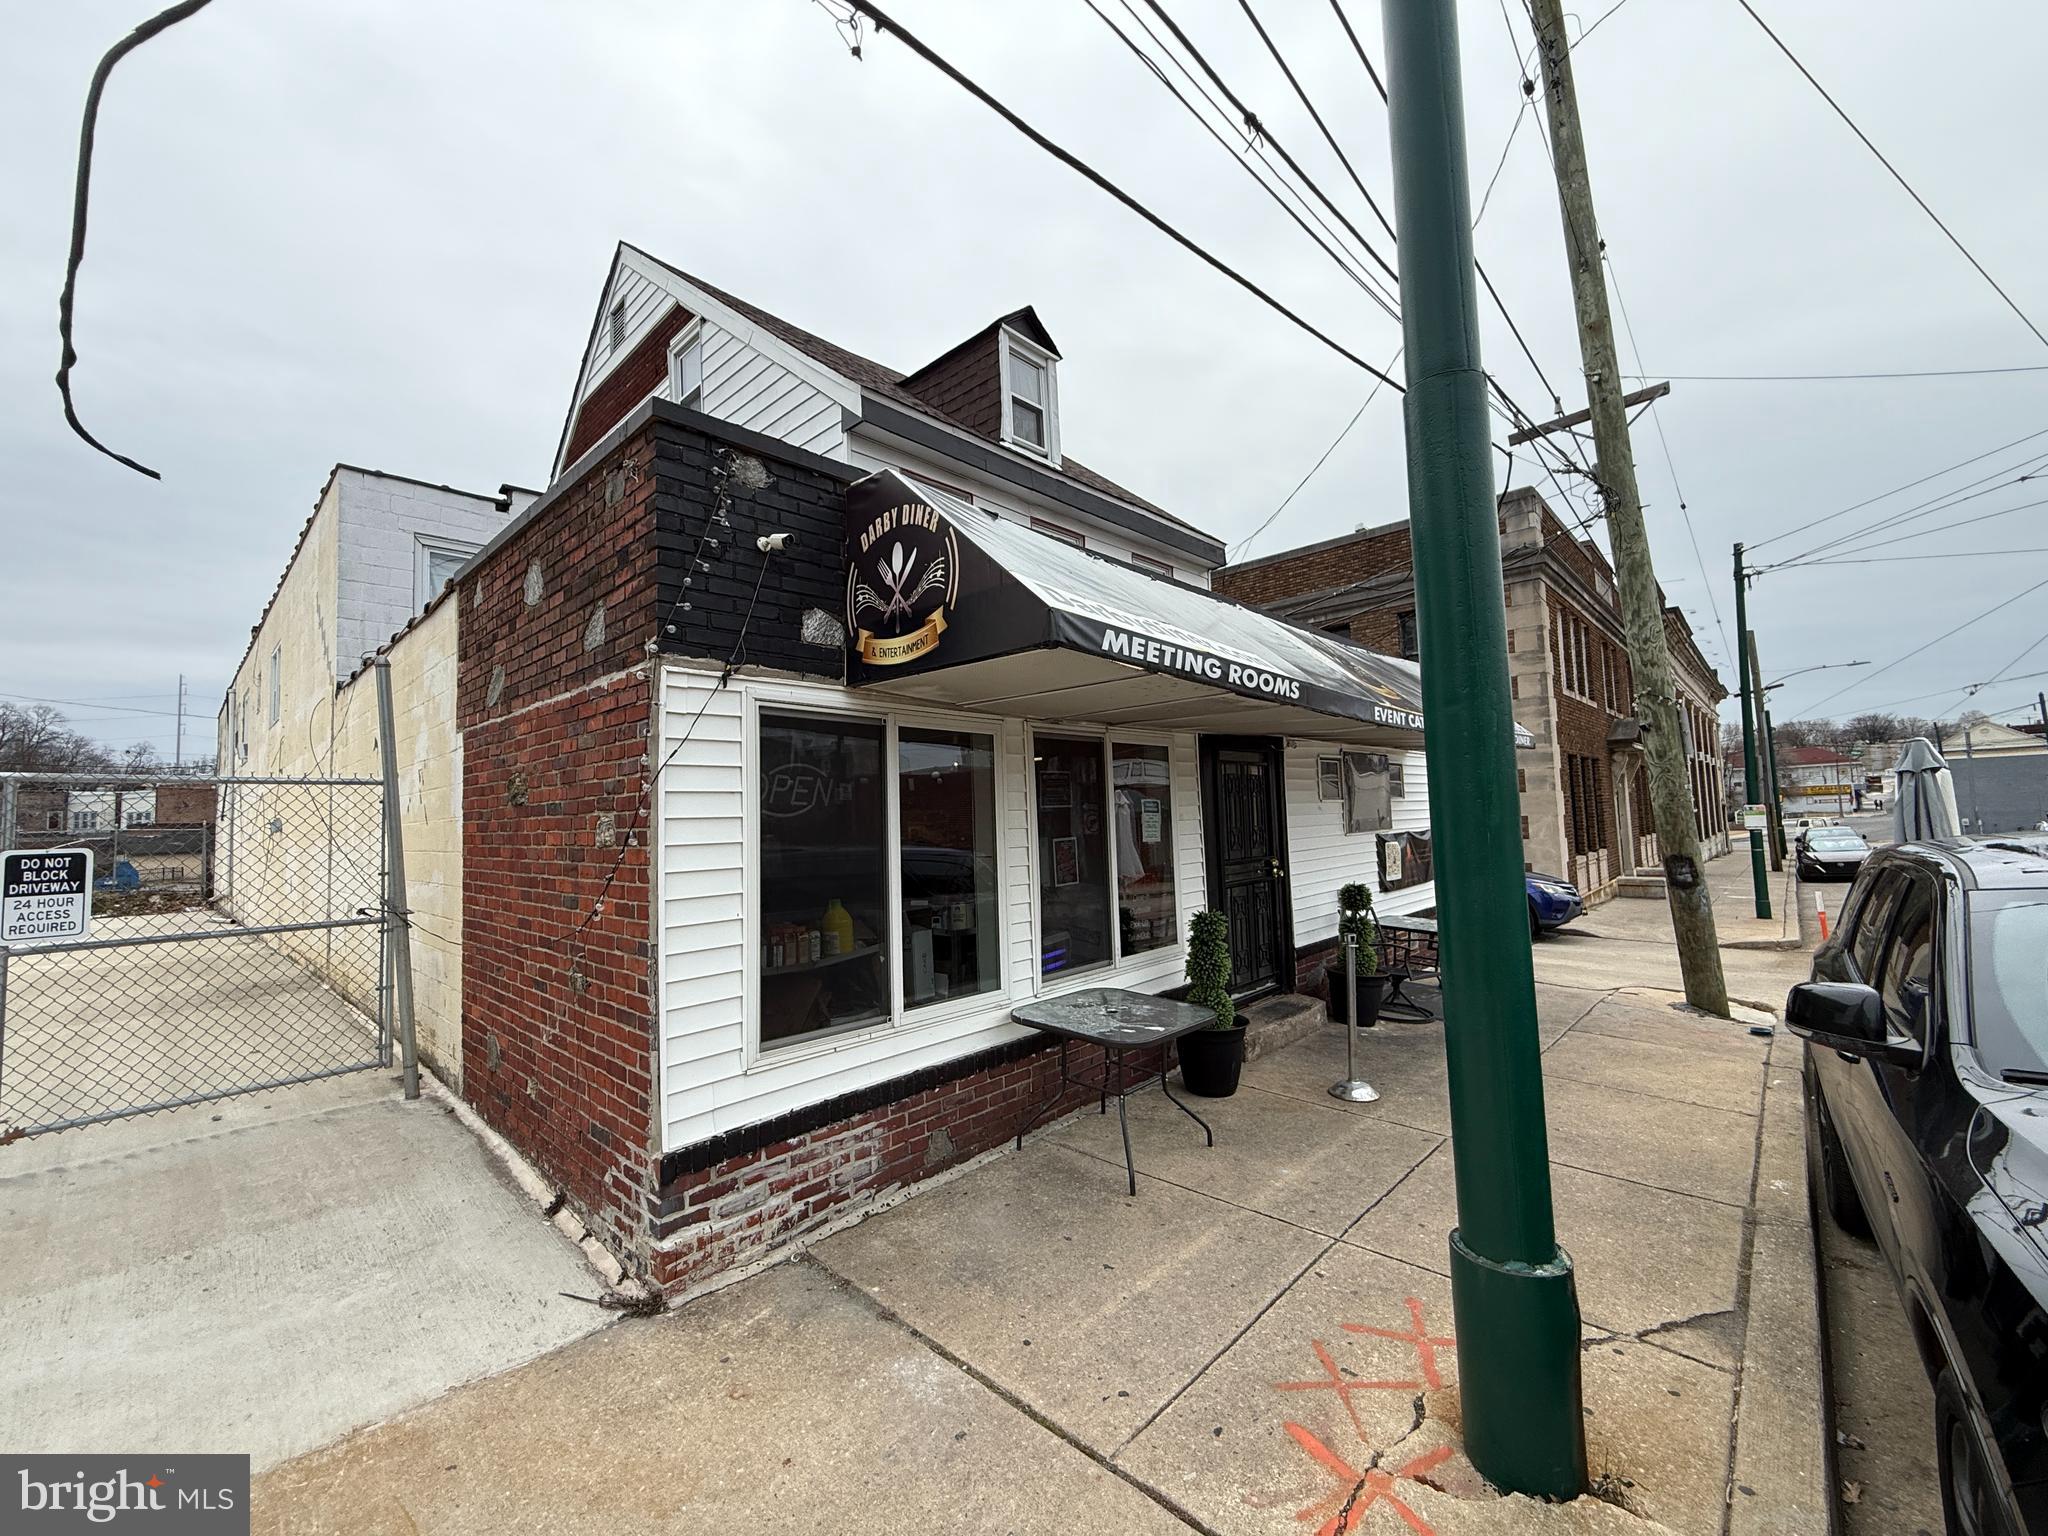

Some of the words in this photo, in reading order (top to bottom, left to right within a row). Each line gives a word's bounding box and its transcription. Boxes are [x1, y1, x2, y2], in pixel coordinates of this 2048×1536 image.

[860, 506, 898, 553] DARBY
[902, 503, 940, 533] DINER
[871, 646, 877, 657] &
[879, 634, 929, 658] ENTERTAINMENT
[1101, 628, 1222, 679] MEETING
[1228, 663, 1300, 700] ROOMS
[1374, 706, 1406, 726] EVENT
[21, 858, 40, 870] DO
[45, 857, 72, 868] NOT
[23, 869, 69, 882] BLOCK
[9, 881, 80, 895] DRIVEWAY
[13, 899, 32, 910] 24
[37, 897, 74, 908] HOUR
[16, 909, 71, 922] ACCESS
[8, 921, 77, 935] REQUIRED
